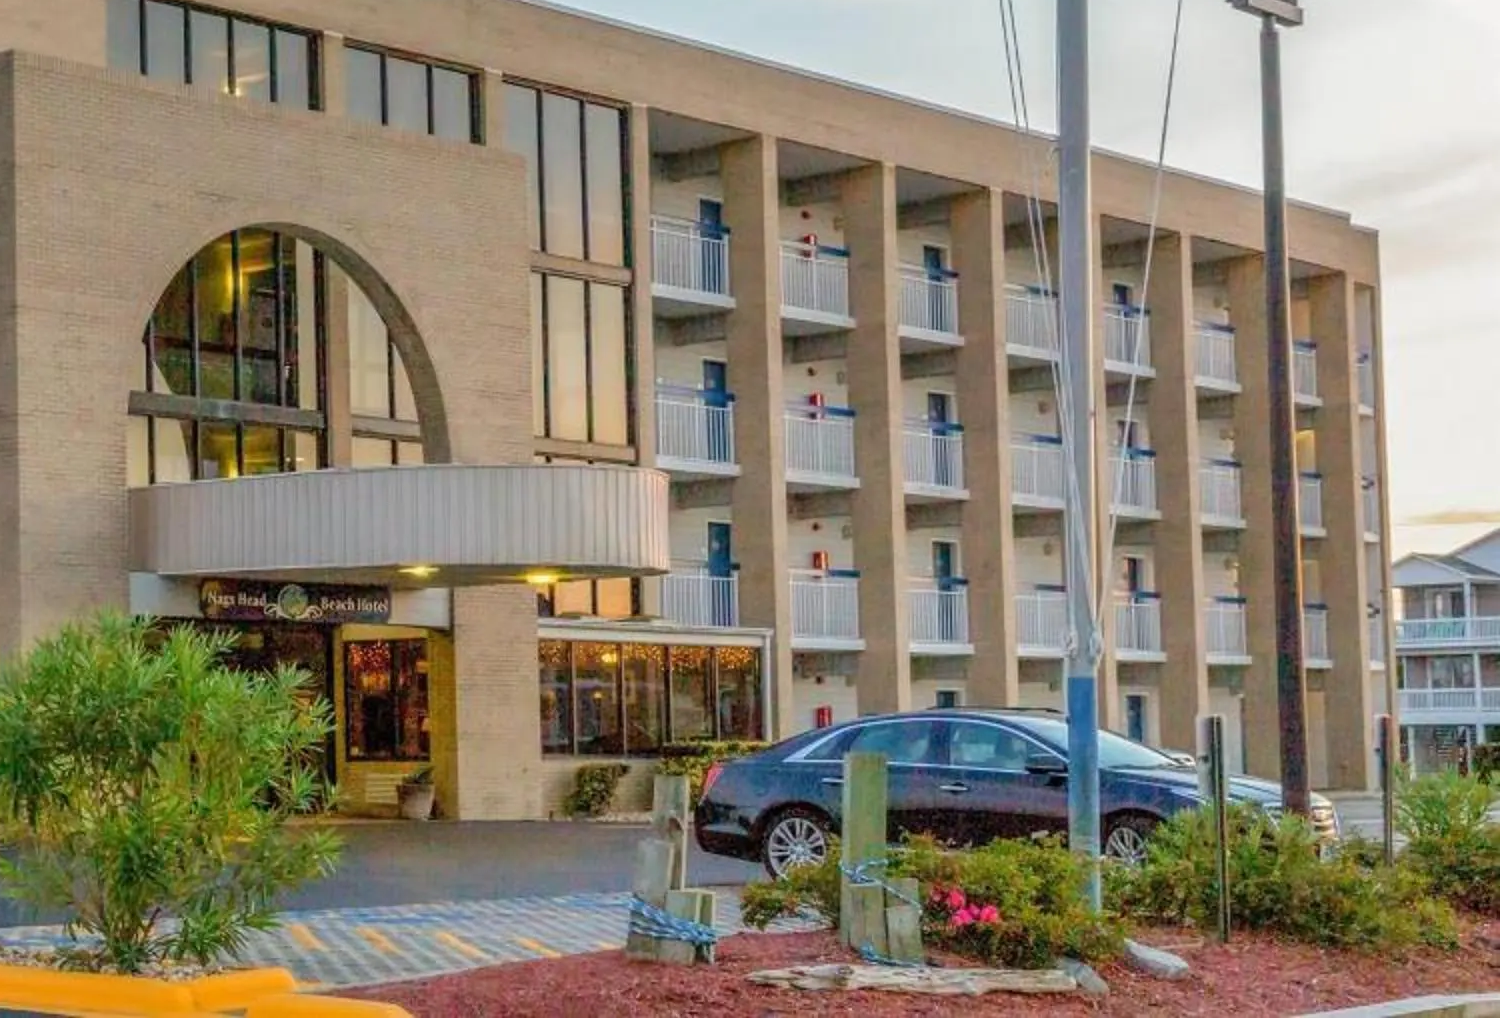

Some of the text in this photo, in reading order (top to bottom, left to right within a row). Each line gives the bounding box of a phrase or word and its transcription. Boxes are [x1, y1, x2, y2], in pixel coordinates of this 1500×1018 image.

[207, 590, 389, 613] Nags Head Beach Hotel
